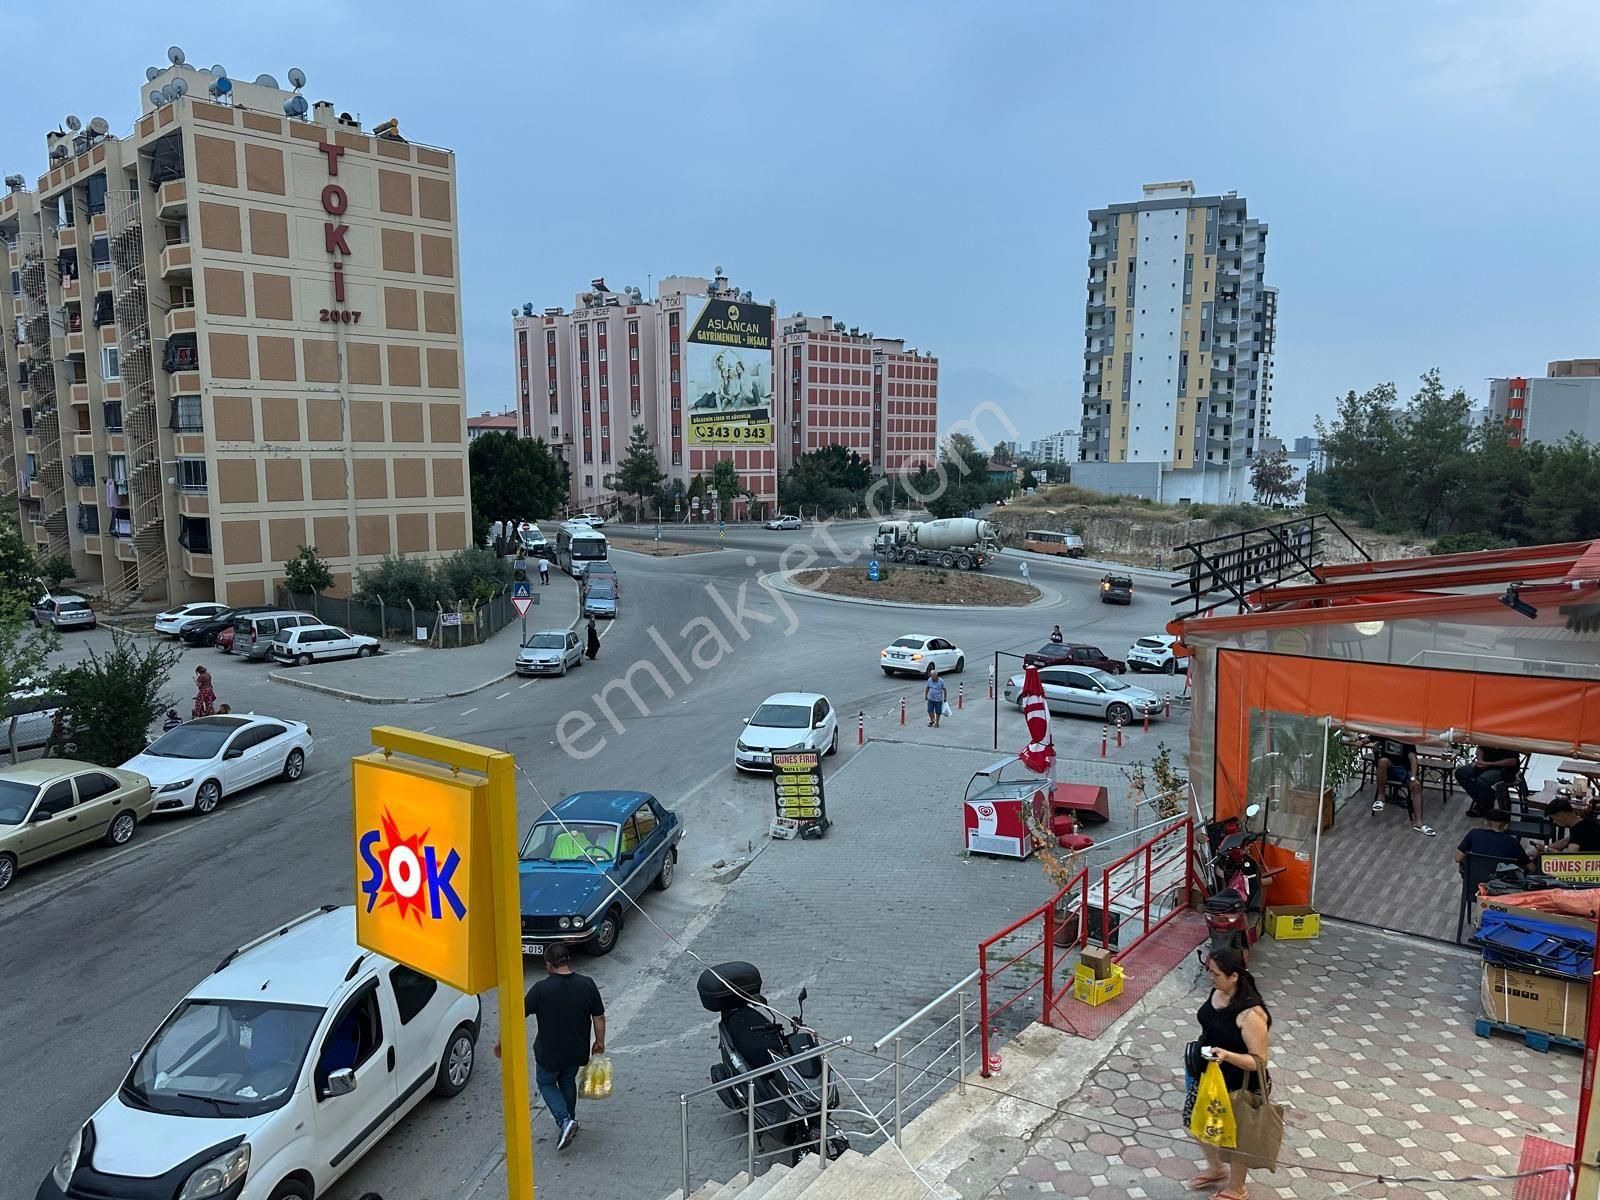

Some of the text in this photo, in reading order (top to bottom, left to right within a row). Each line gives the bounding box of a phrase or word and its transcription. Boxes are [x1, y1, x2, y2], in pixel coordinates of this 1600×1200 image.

[319, 309, 361, 324] 2007
[707, 318, 759, 334] ASLANCAN
[697, 329, 741, 344] GAYRİMENKUL
[746, 333, 768, 347] İNŞAAT
[707, 426, 766, 439] 343 0 343
[799, 754, 817, 764] FIRIN
[1544, 858, 1581, 873] GÜNEŞ
[359, 829, 467, 922] ŞOK
